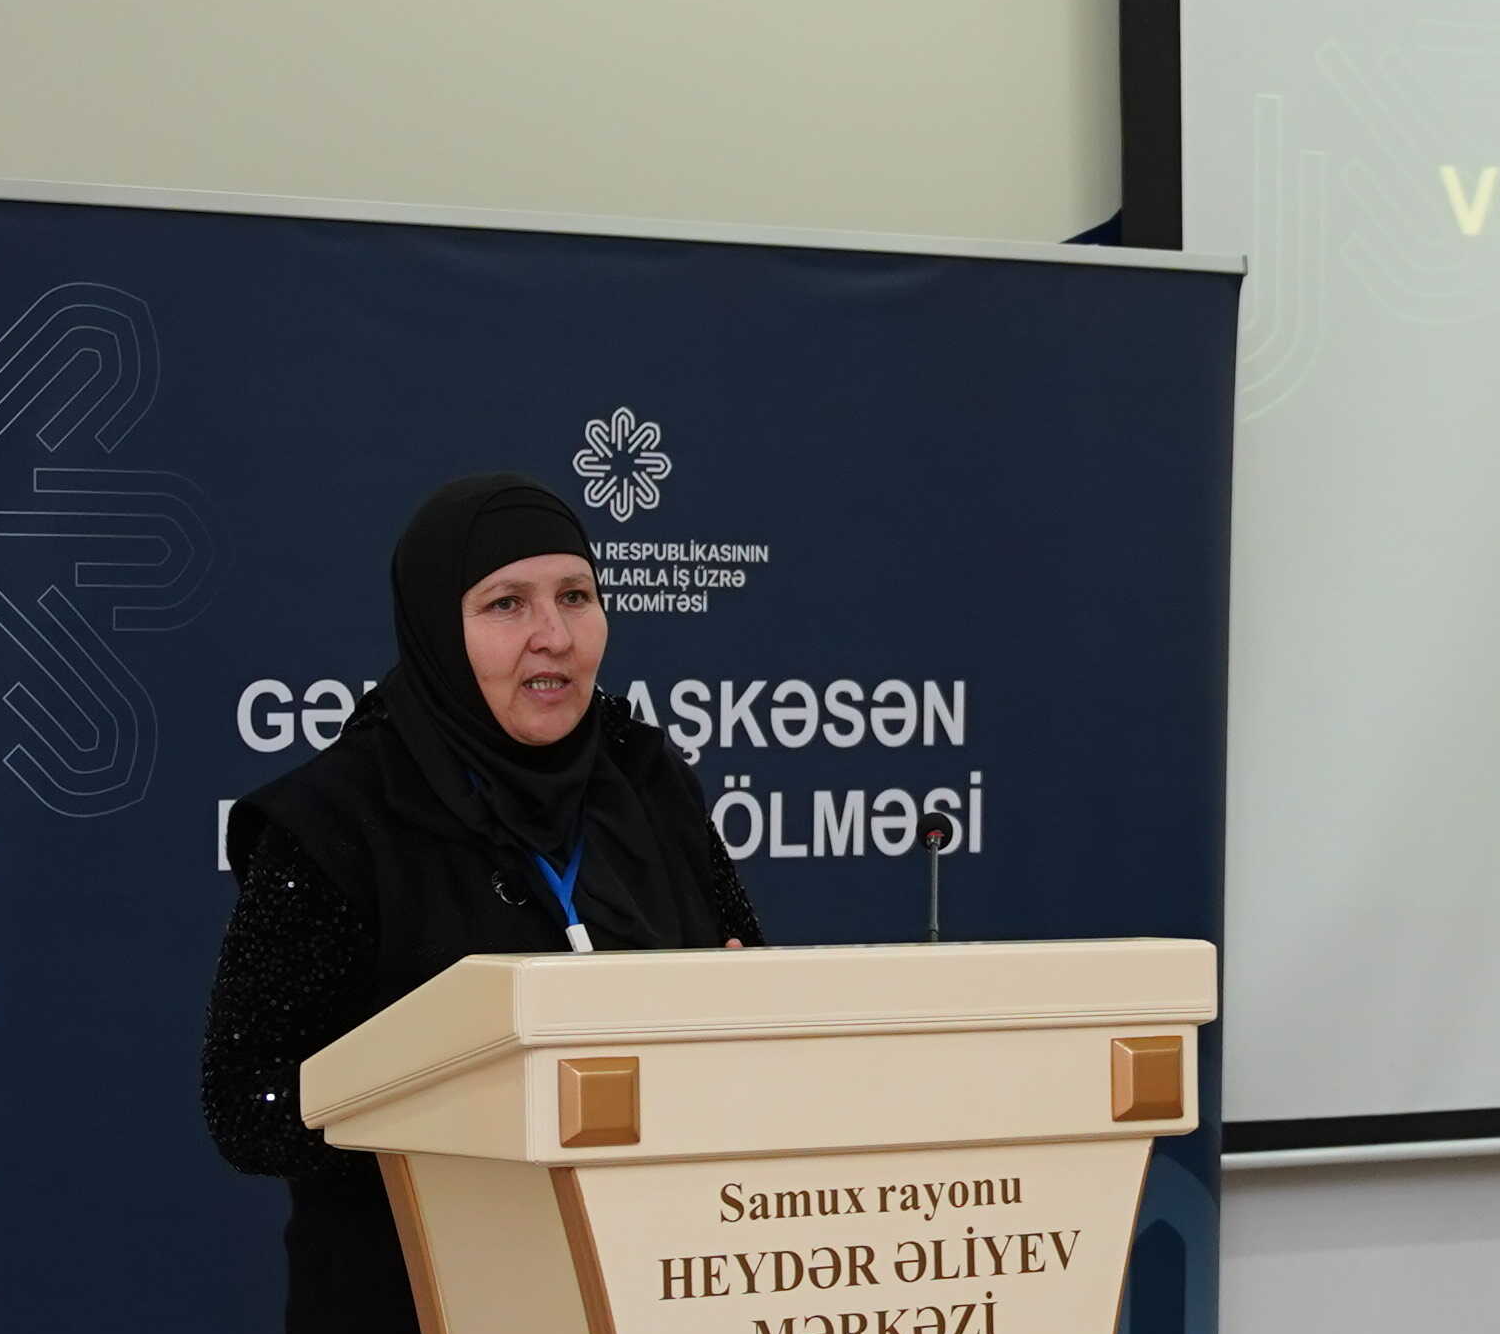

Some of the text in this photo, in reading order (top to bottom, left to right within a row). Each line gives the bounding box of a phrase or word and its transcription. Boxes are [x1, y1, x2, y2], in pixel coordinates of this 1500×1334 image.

[606, 540, 769, 563] RESPUBLİKASININ
[597, 565, 746, 591] MLARLA İŞ ÜZRƏ
[616, 590, 708, 613] KOMİTƏSİ
[626, 679, 966, 766] AŞKƏSƏN
[711, 771, 983, 861] ÖLMƏSİ
[719, 1175, 1024, 1223] Samux rayonu
[658, 1226, 1081, 1301] HEYDƏR ƏLİYEV
